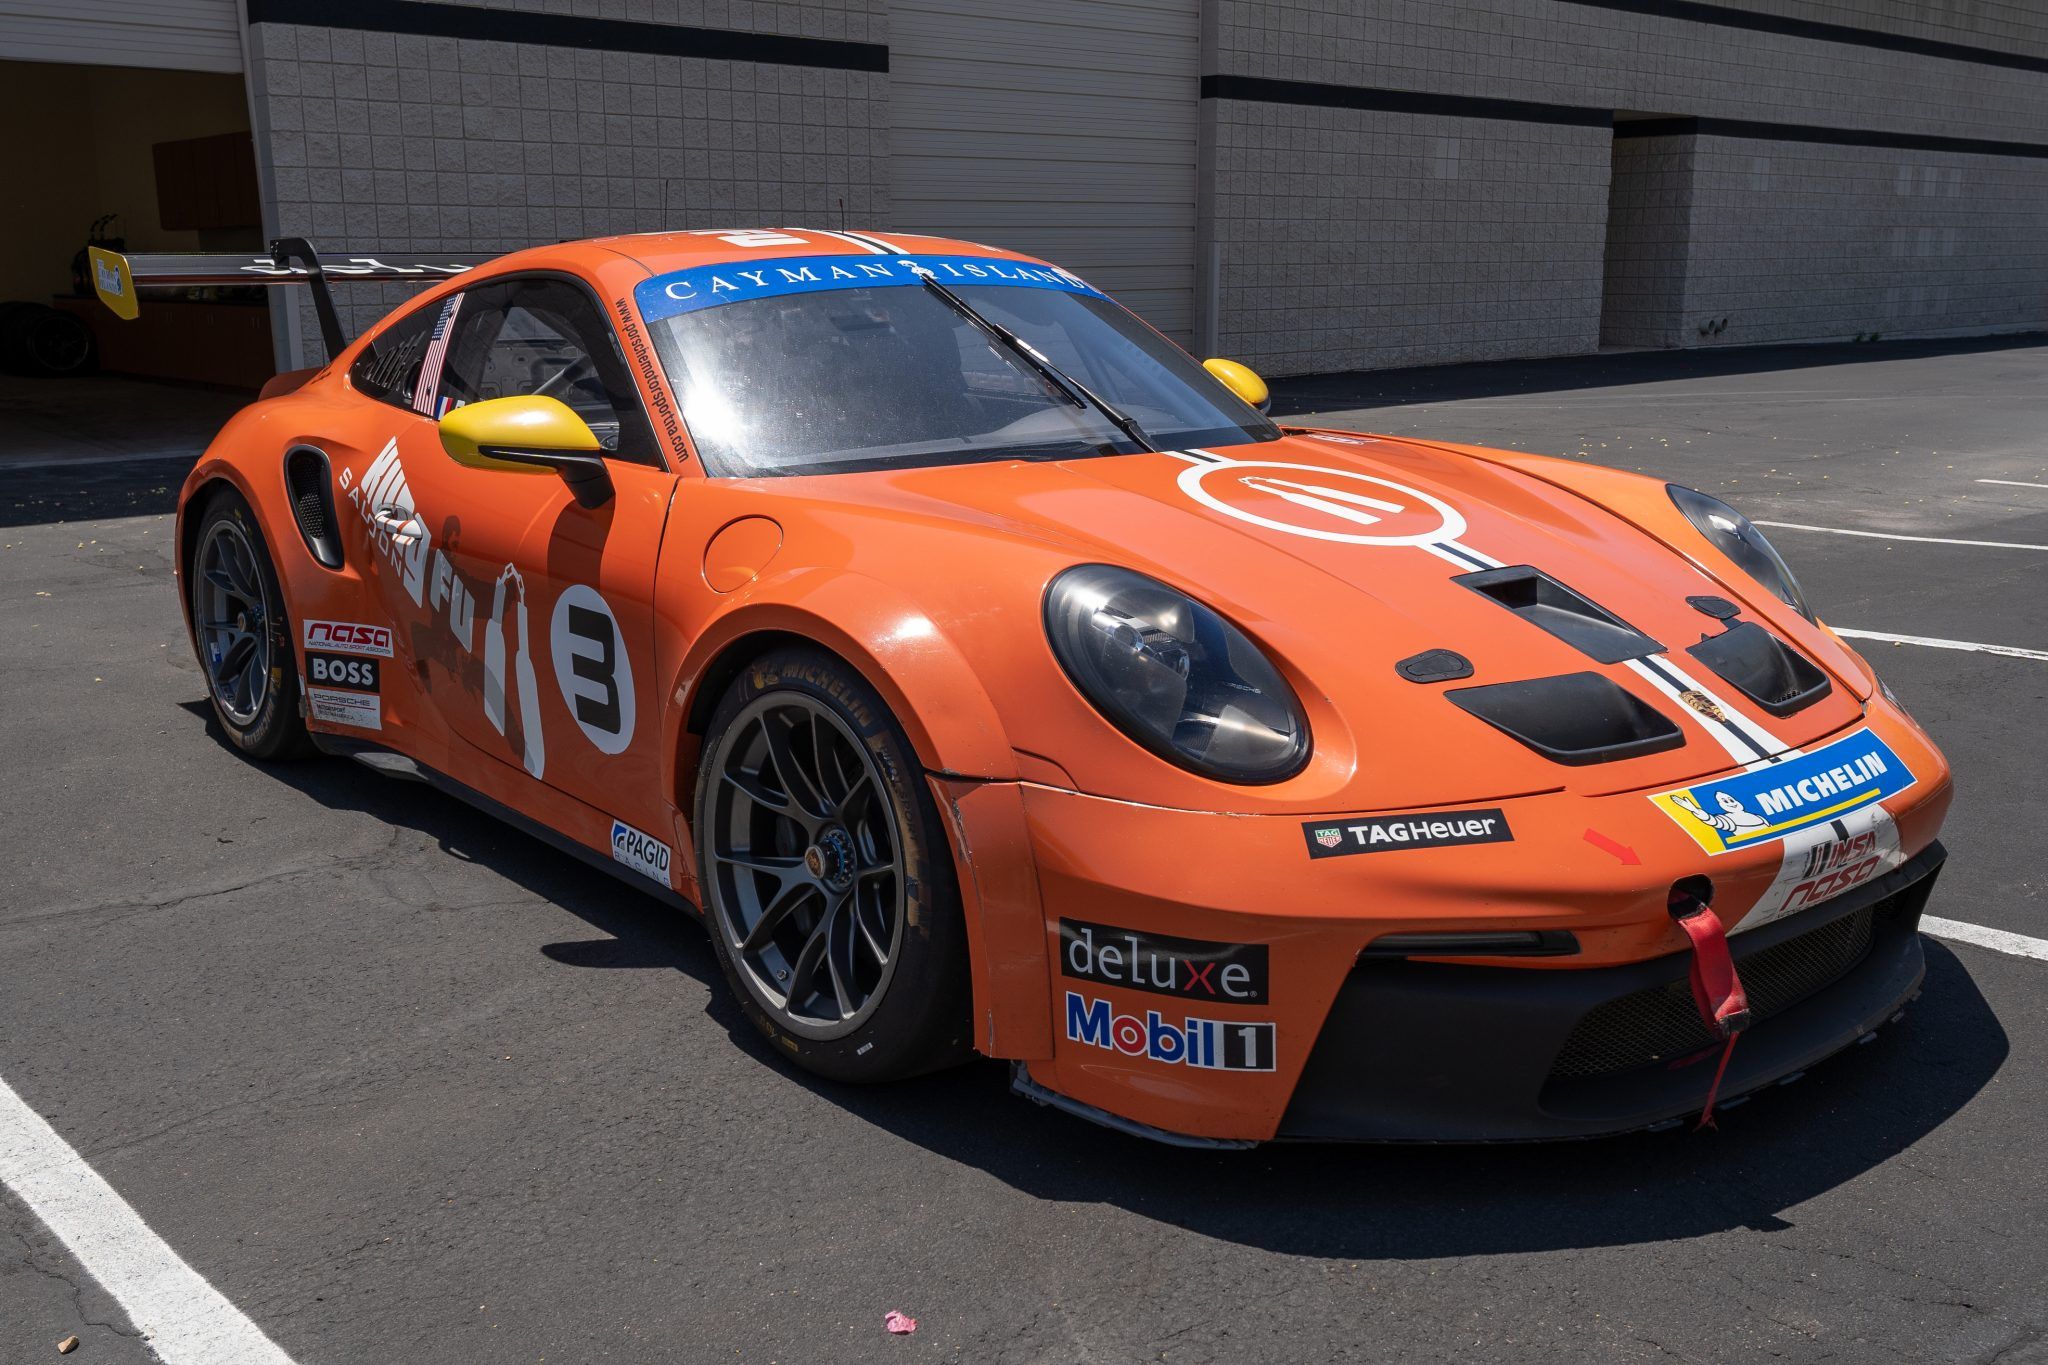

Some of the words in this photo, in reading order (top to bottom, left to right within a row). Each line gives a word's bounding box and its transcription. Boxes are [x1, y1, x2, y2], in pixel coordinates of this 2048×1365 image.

[664, 262, 885, 301] CAYMAN
[616, 298, 689, 463] www.porschemotorsportna.com
[313, 659, 374, 686] BOSS
[568, 604, 622, 735] 3
[314, 693, 371, 707] PORSCHE
[781, 661, 875, 728] MICHELIN
[1754, 750, 1888, 816] MICHELIN
[626, 830, 669, 872] PAGID
[1317, 830, 1339, 838] TAG
[1827, 830, 1876, 870] IMSA
[1065, 990, 1219, 1066] Mobil
[1238, 1026, 1257, 1067] 1
